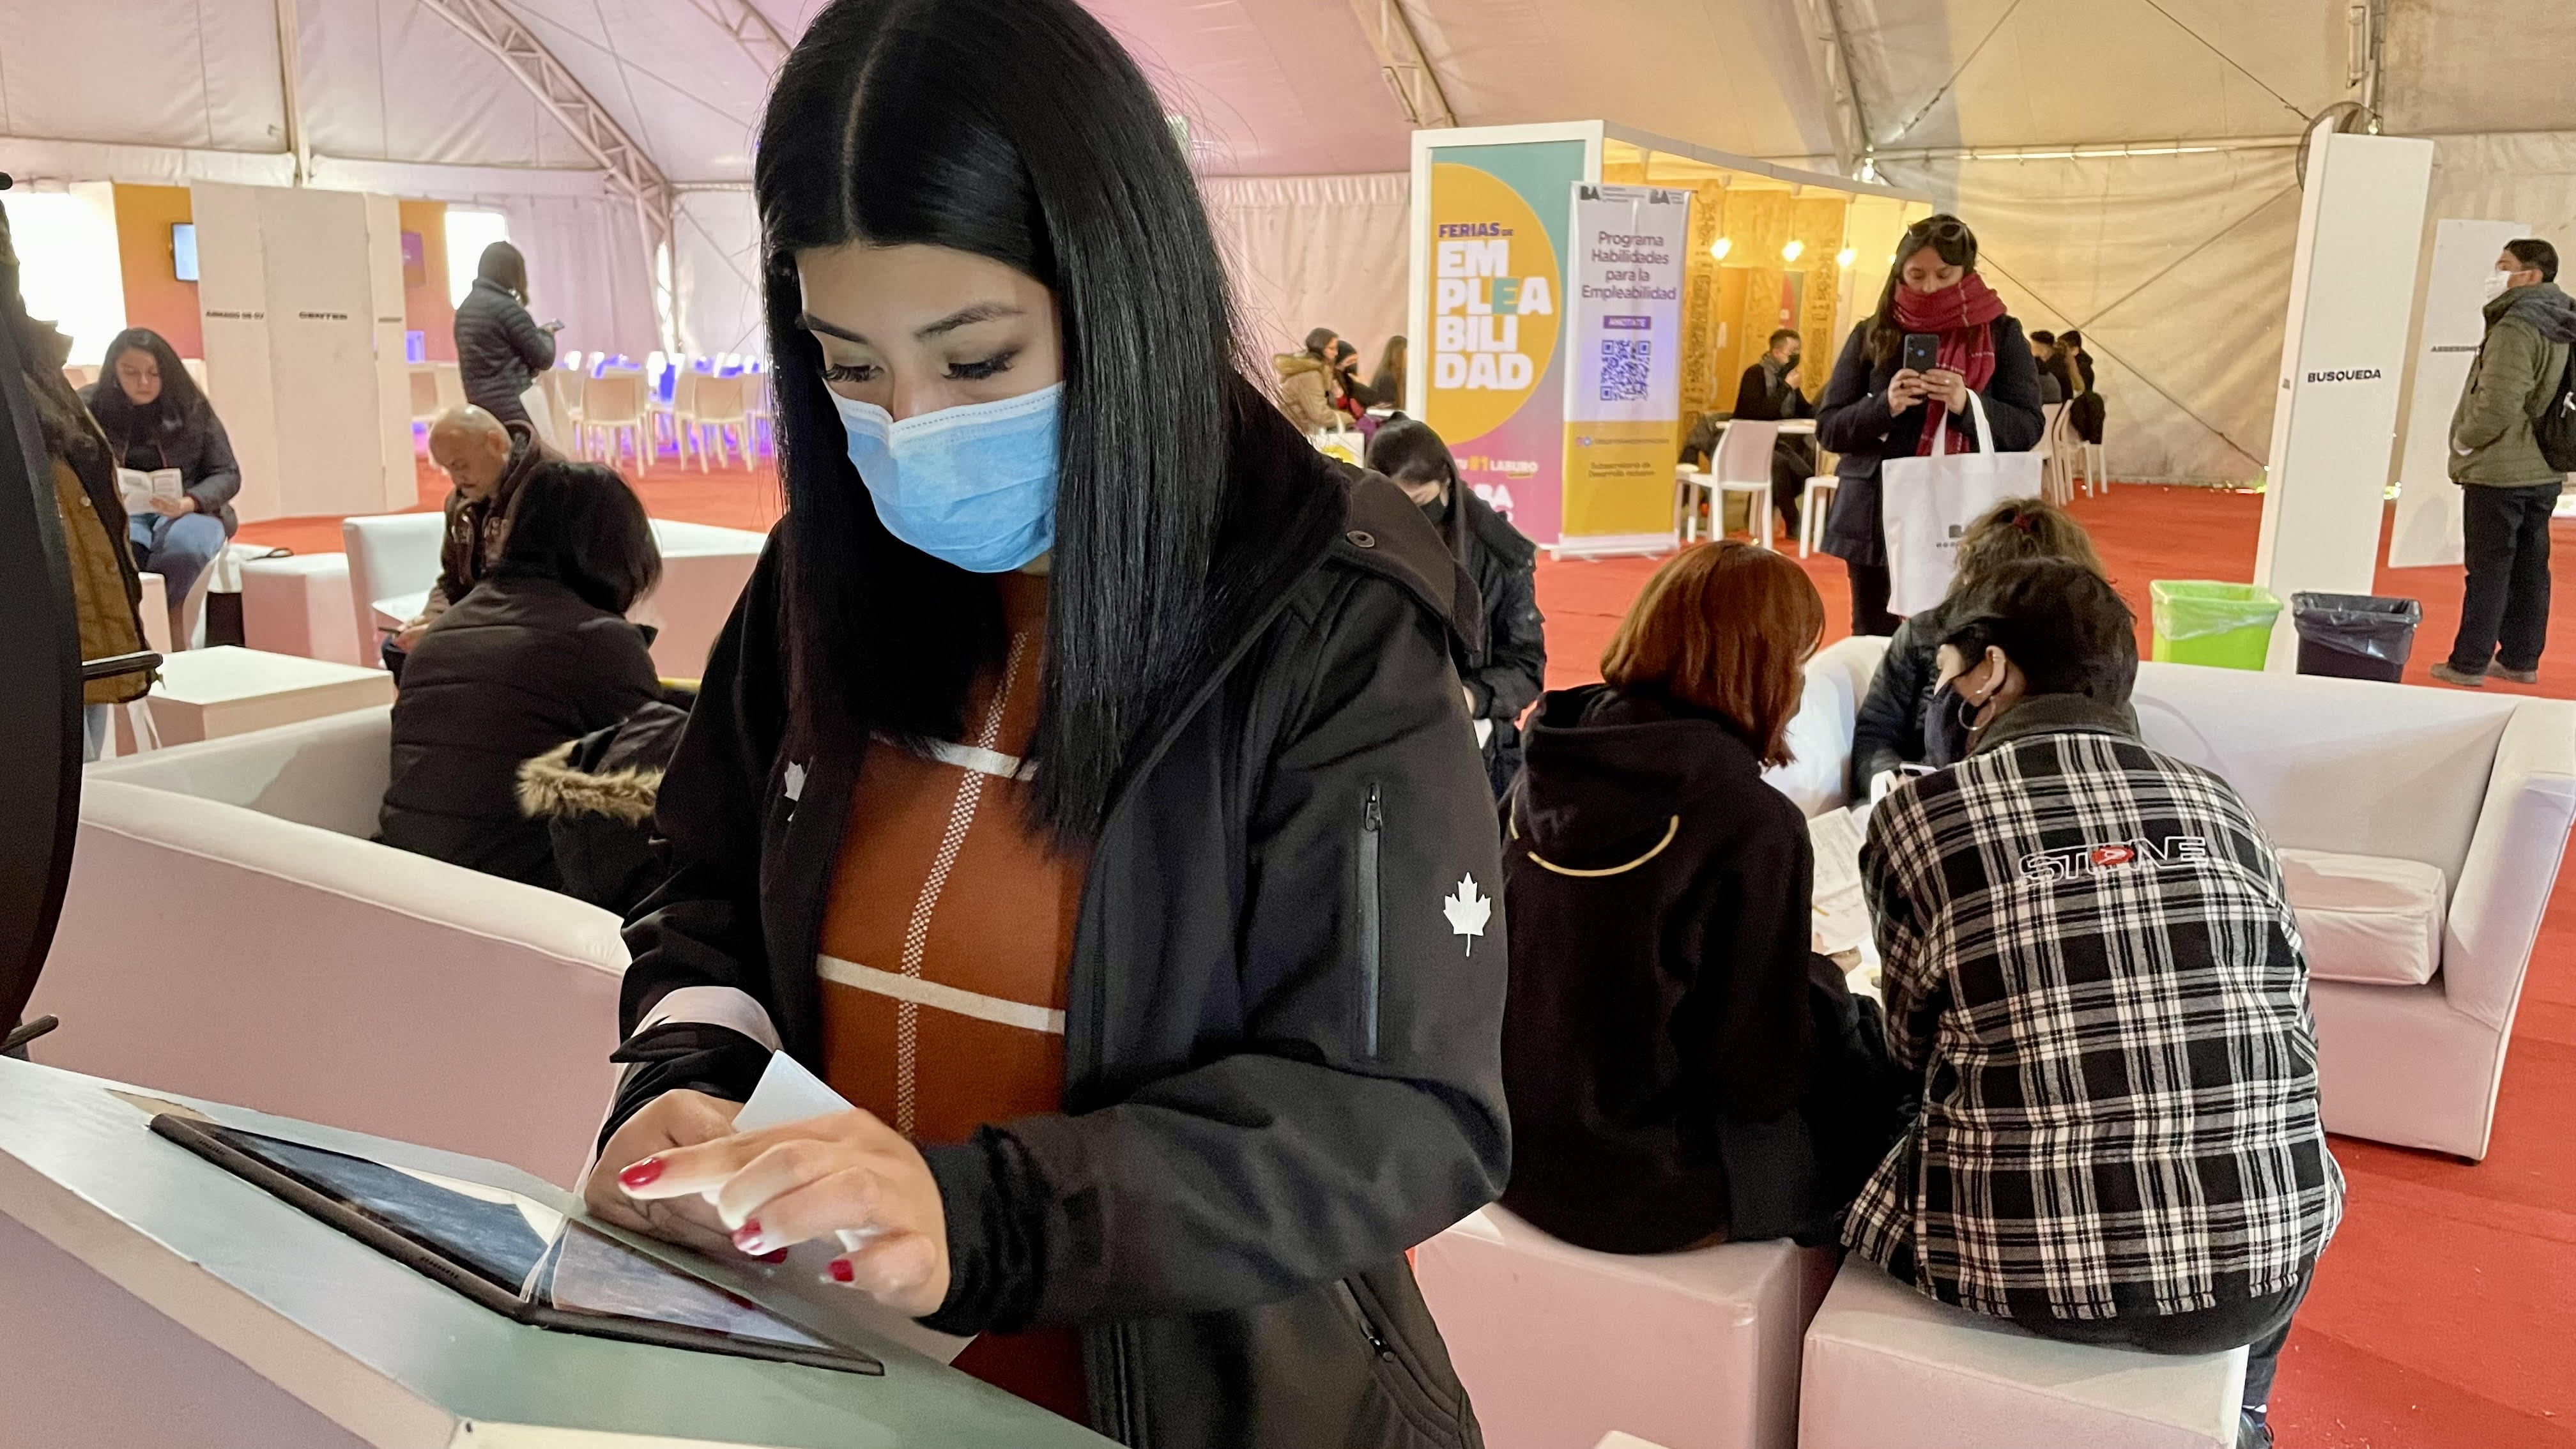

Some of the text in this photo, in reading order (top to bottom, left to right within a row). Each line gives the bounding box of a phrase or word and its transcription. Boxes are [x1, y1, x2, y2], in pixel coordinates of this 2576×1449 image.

[1438, 223, 1500, 238] FERIAS
[1598, 231, 1664, 248] Programa
[1437, 239, 1509, 277] EM
[1591, 249, 1669, 264] Habilidades
[1605, 268, 1650, 283] para la
[1436, 276, 1553, 315] PLEA
[1581, 285, 1677, 301] Empleabilidad
[1436, 315, 1519, 352] BILI
[1434, 352, 1534, 390] DAD
[2308, 369, 2382, 383] BUSQUEDA
[1490, 459, 1539, 473] LABURO
